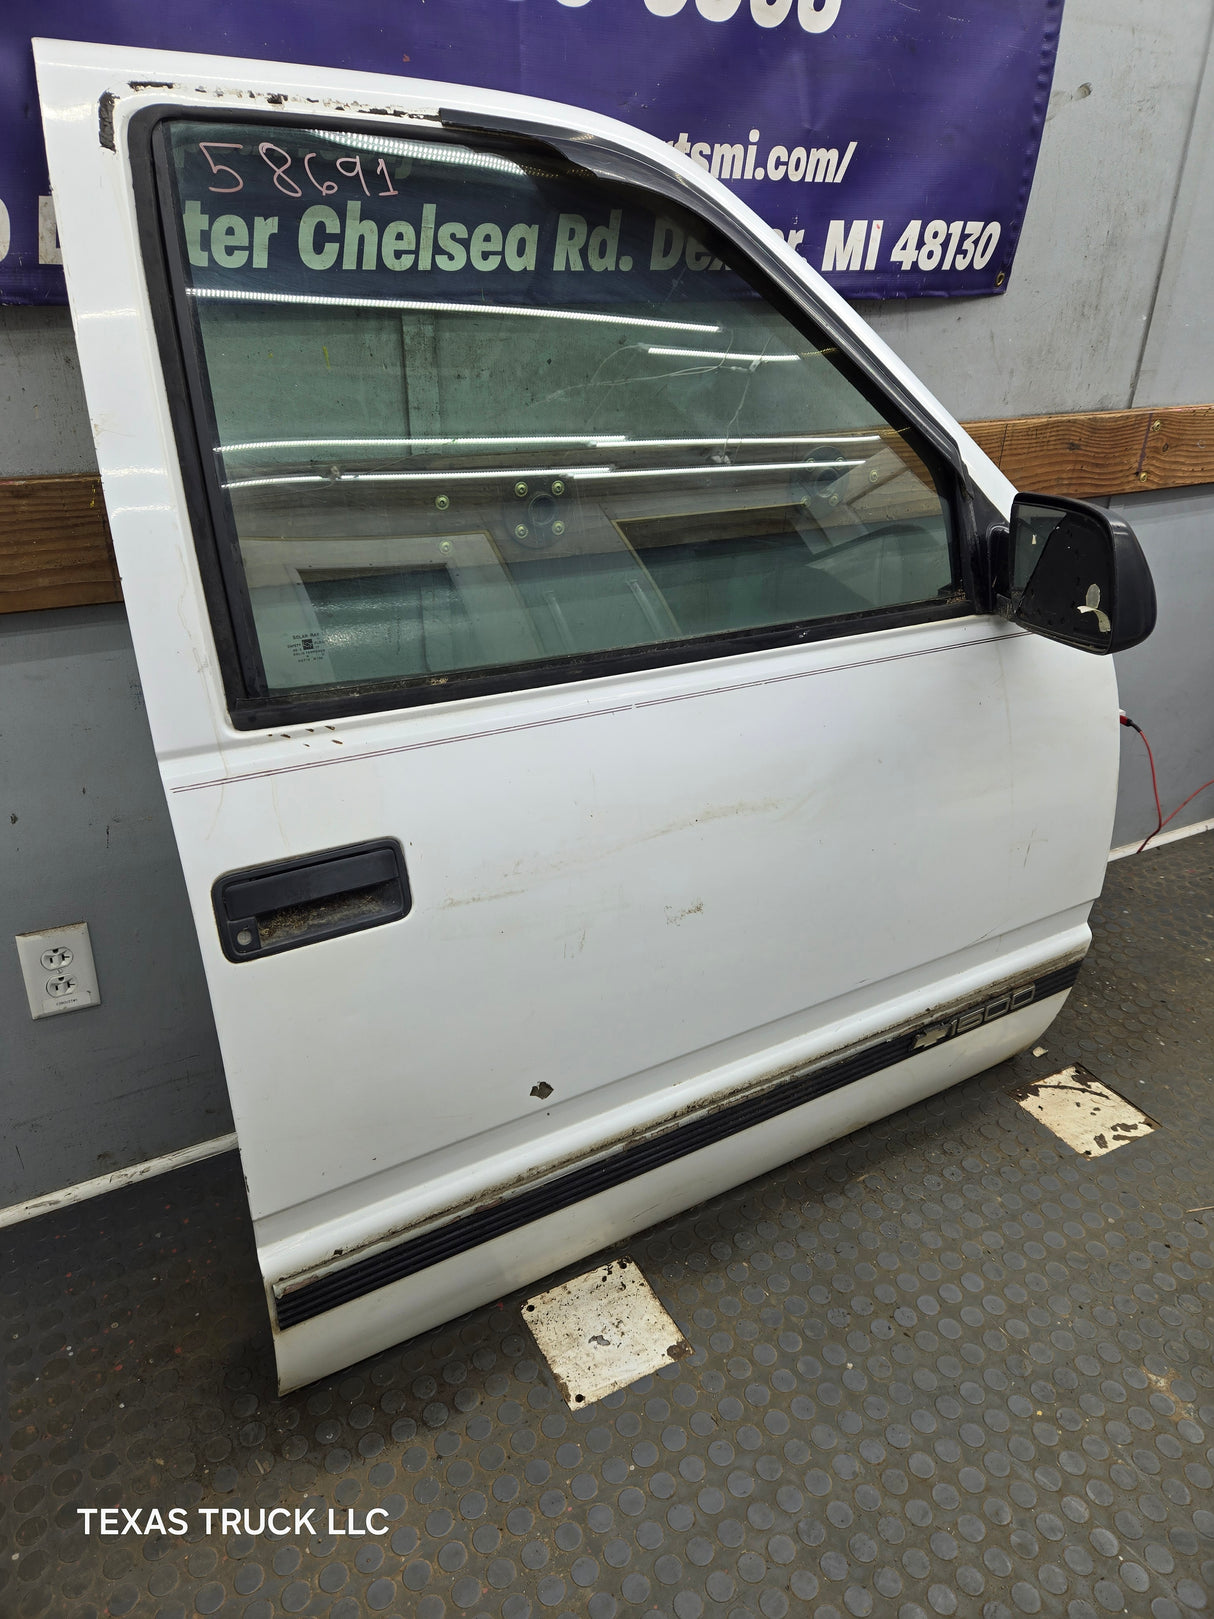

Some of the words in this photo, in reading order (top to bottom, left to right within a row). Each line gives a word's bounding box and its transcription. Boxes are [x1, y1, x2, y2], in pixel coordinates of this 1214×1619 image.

[200, 142, 398, 197] 58691
[664, 129, 858, 183] tsmi.com/
[298, 200, 539, 272] Chelsea
[553, 209, 633, 272] Rd.
[821, 219, 884, 271] MI
[890, 219, 1001, 271] 48130
[951, 983, 1036, 1036] 1500
